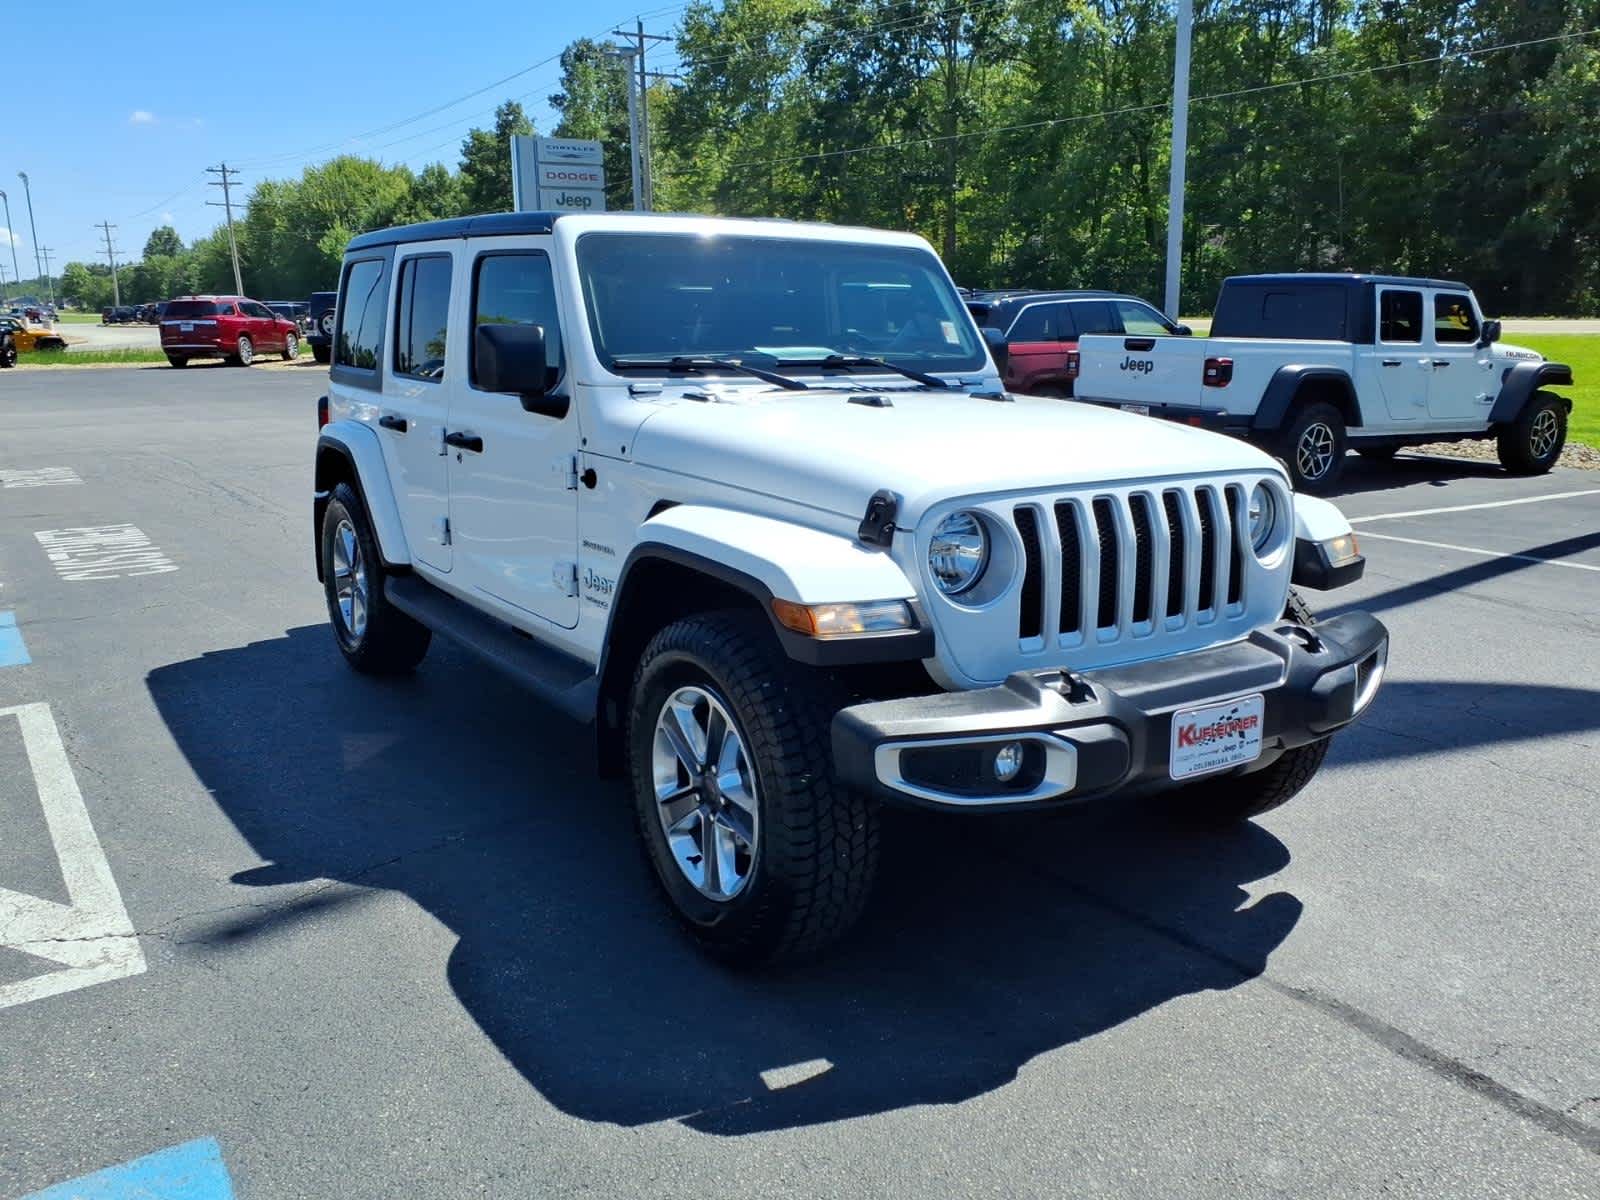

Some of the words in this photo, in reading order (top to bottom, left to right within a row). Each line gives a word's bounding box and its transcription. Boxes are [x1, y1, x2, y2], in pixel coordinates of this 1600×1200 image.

[546, 171, 599, 181] DODGE
[556, 191, 592, 210] Jeep
[1120, 356, 1154, 374] Jeep
